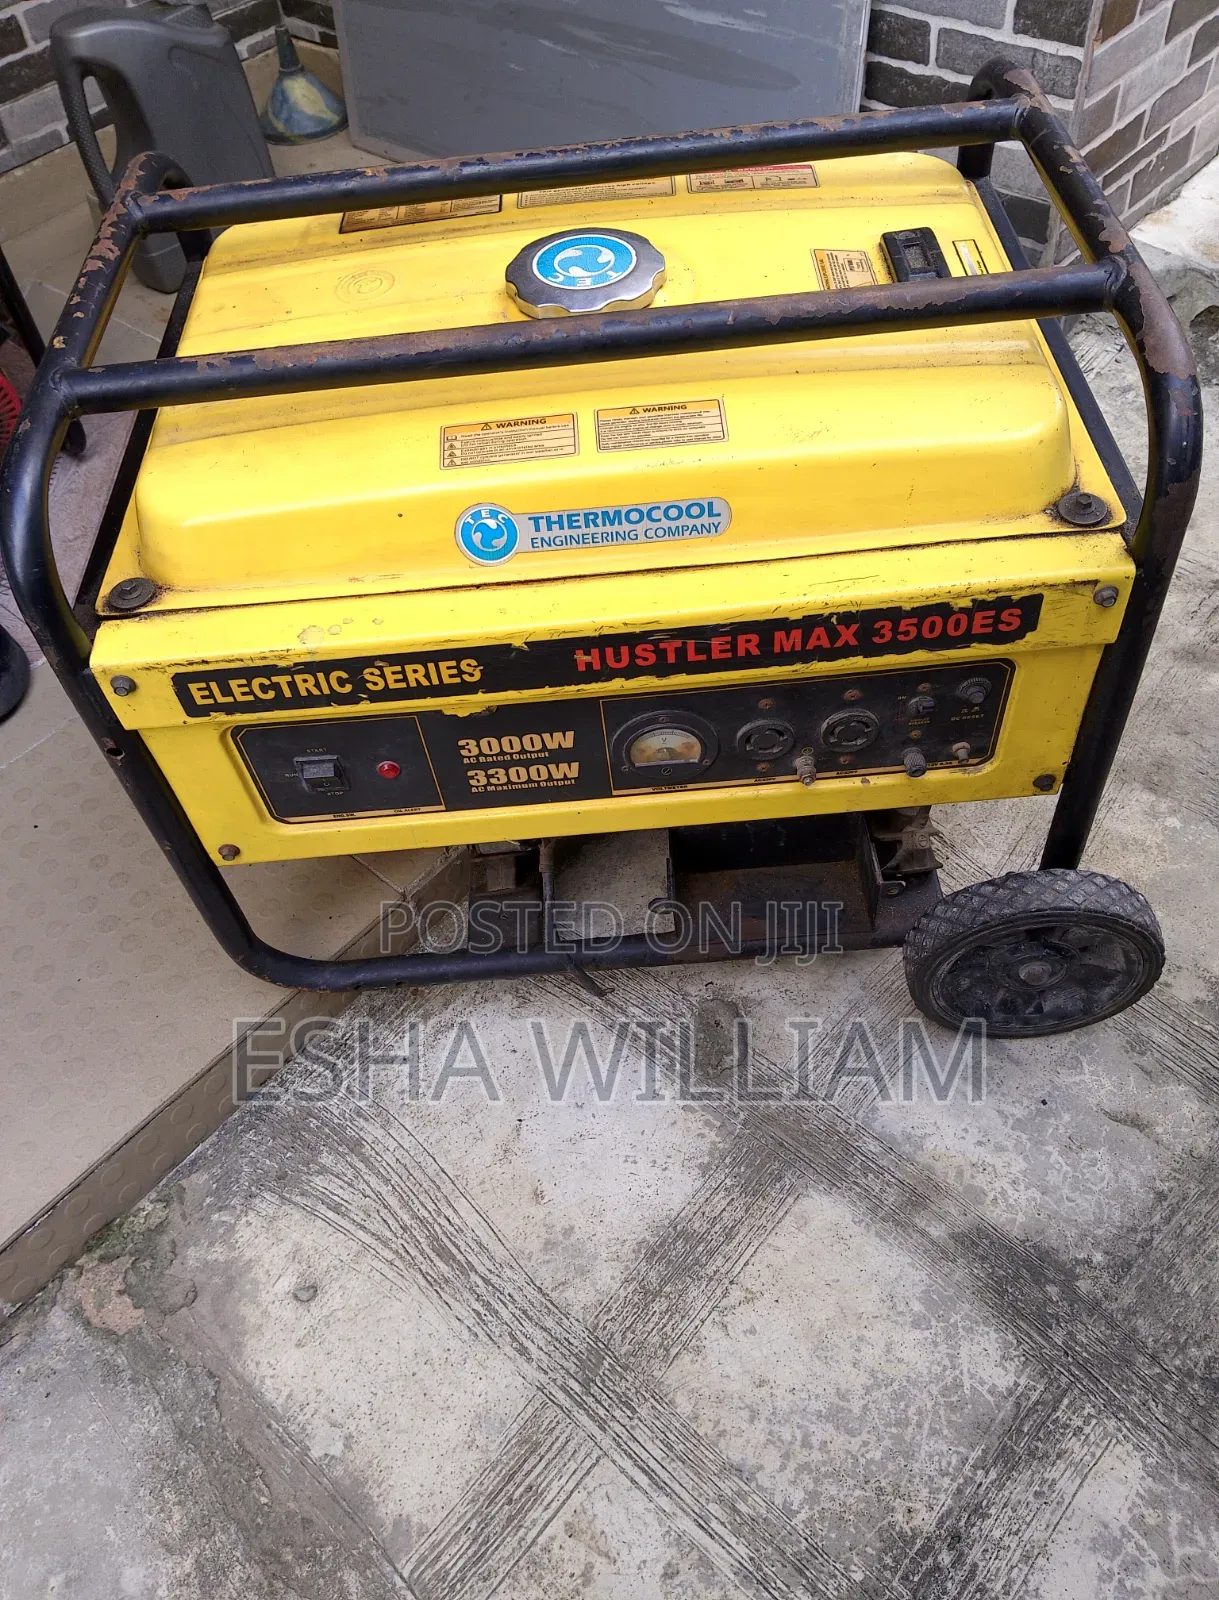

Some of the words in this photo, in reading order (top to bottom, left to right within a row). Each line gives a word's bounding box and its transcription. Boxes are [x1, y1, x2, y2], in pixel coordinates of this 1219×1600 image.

[548, 271, 623, 287] TEC
[643, 404, 687, 414] WARNING
[495, 418, 547, 429] WARNING
[464, 509, 509, 525] TEC
[528, 500, 721, 533] THERMOCOOL
[530, 531, 639, 549] ENGINEERING
[644, 521, 721, 540] COMPANY
[575, 633, 762, 673] HUSTLER
[773, 623, 861, 655] MAX
[872, 608, 1023, 645] 3500ES
[188, 670, 354, 706] ELECTRIC
[362, 658, 484, 692] SERIES
[457, 730, 575, 757] 3000W
[479, 754, 511, 763] Rated
[513, 751, 549, 760] Output
[467, 762, 580, 787] 3300W
[487, 782, 538, 792] Maximum
[540, 779, 576, 788] Output
